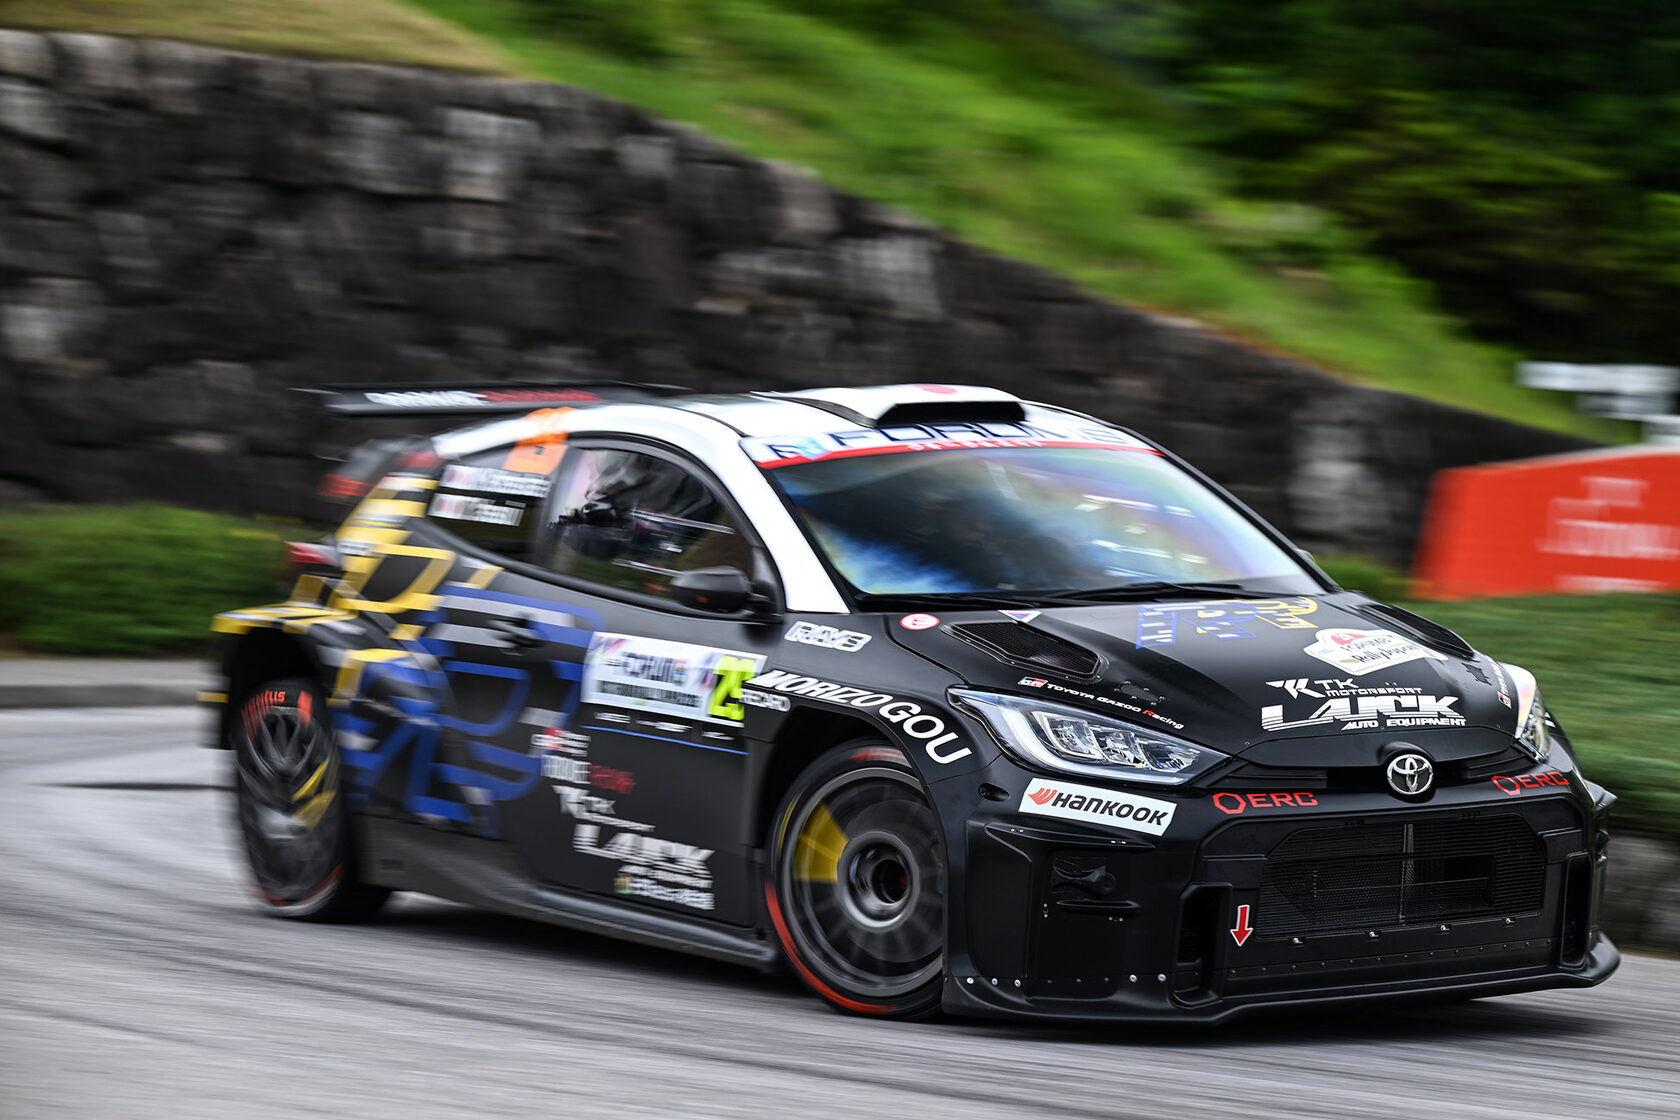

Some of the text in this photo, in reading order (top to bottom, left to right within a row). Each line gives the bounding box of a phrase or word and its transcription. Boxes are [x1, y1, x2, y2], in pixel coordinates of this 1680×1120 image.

[1314, 678, 1359, 690] TK
[1047, 683, 1095, 700] TOYOTA
[1096, 697, 1142, 713] GAZOO
[1324, 687, 1423, 698] MOTORSPORT
[1340, 718, 1467, 731] AUTO EQUIPMENT
